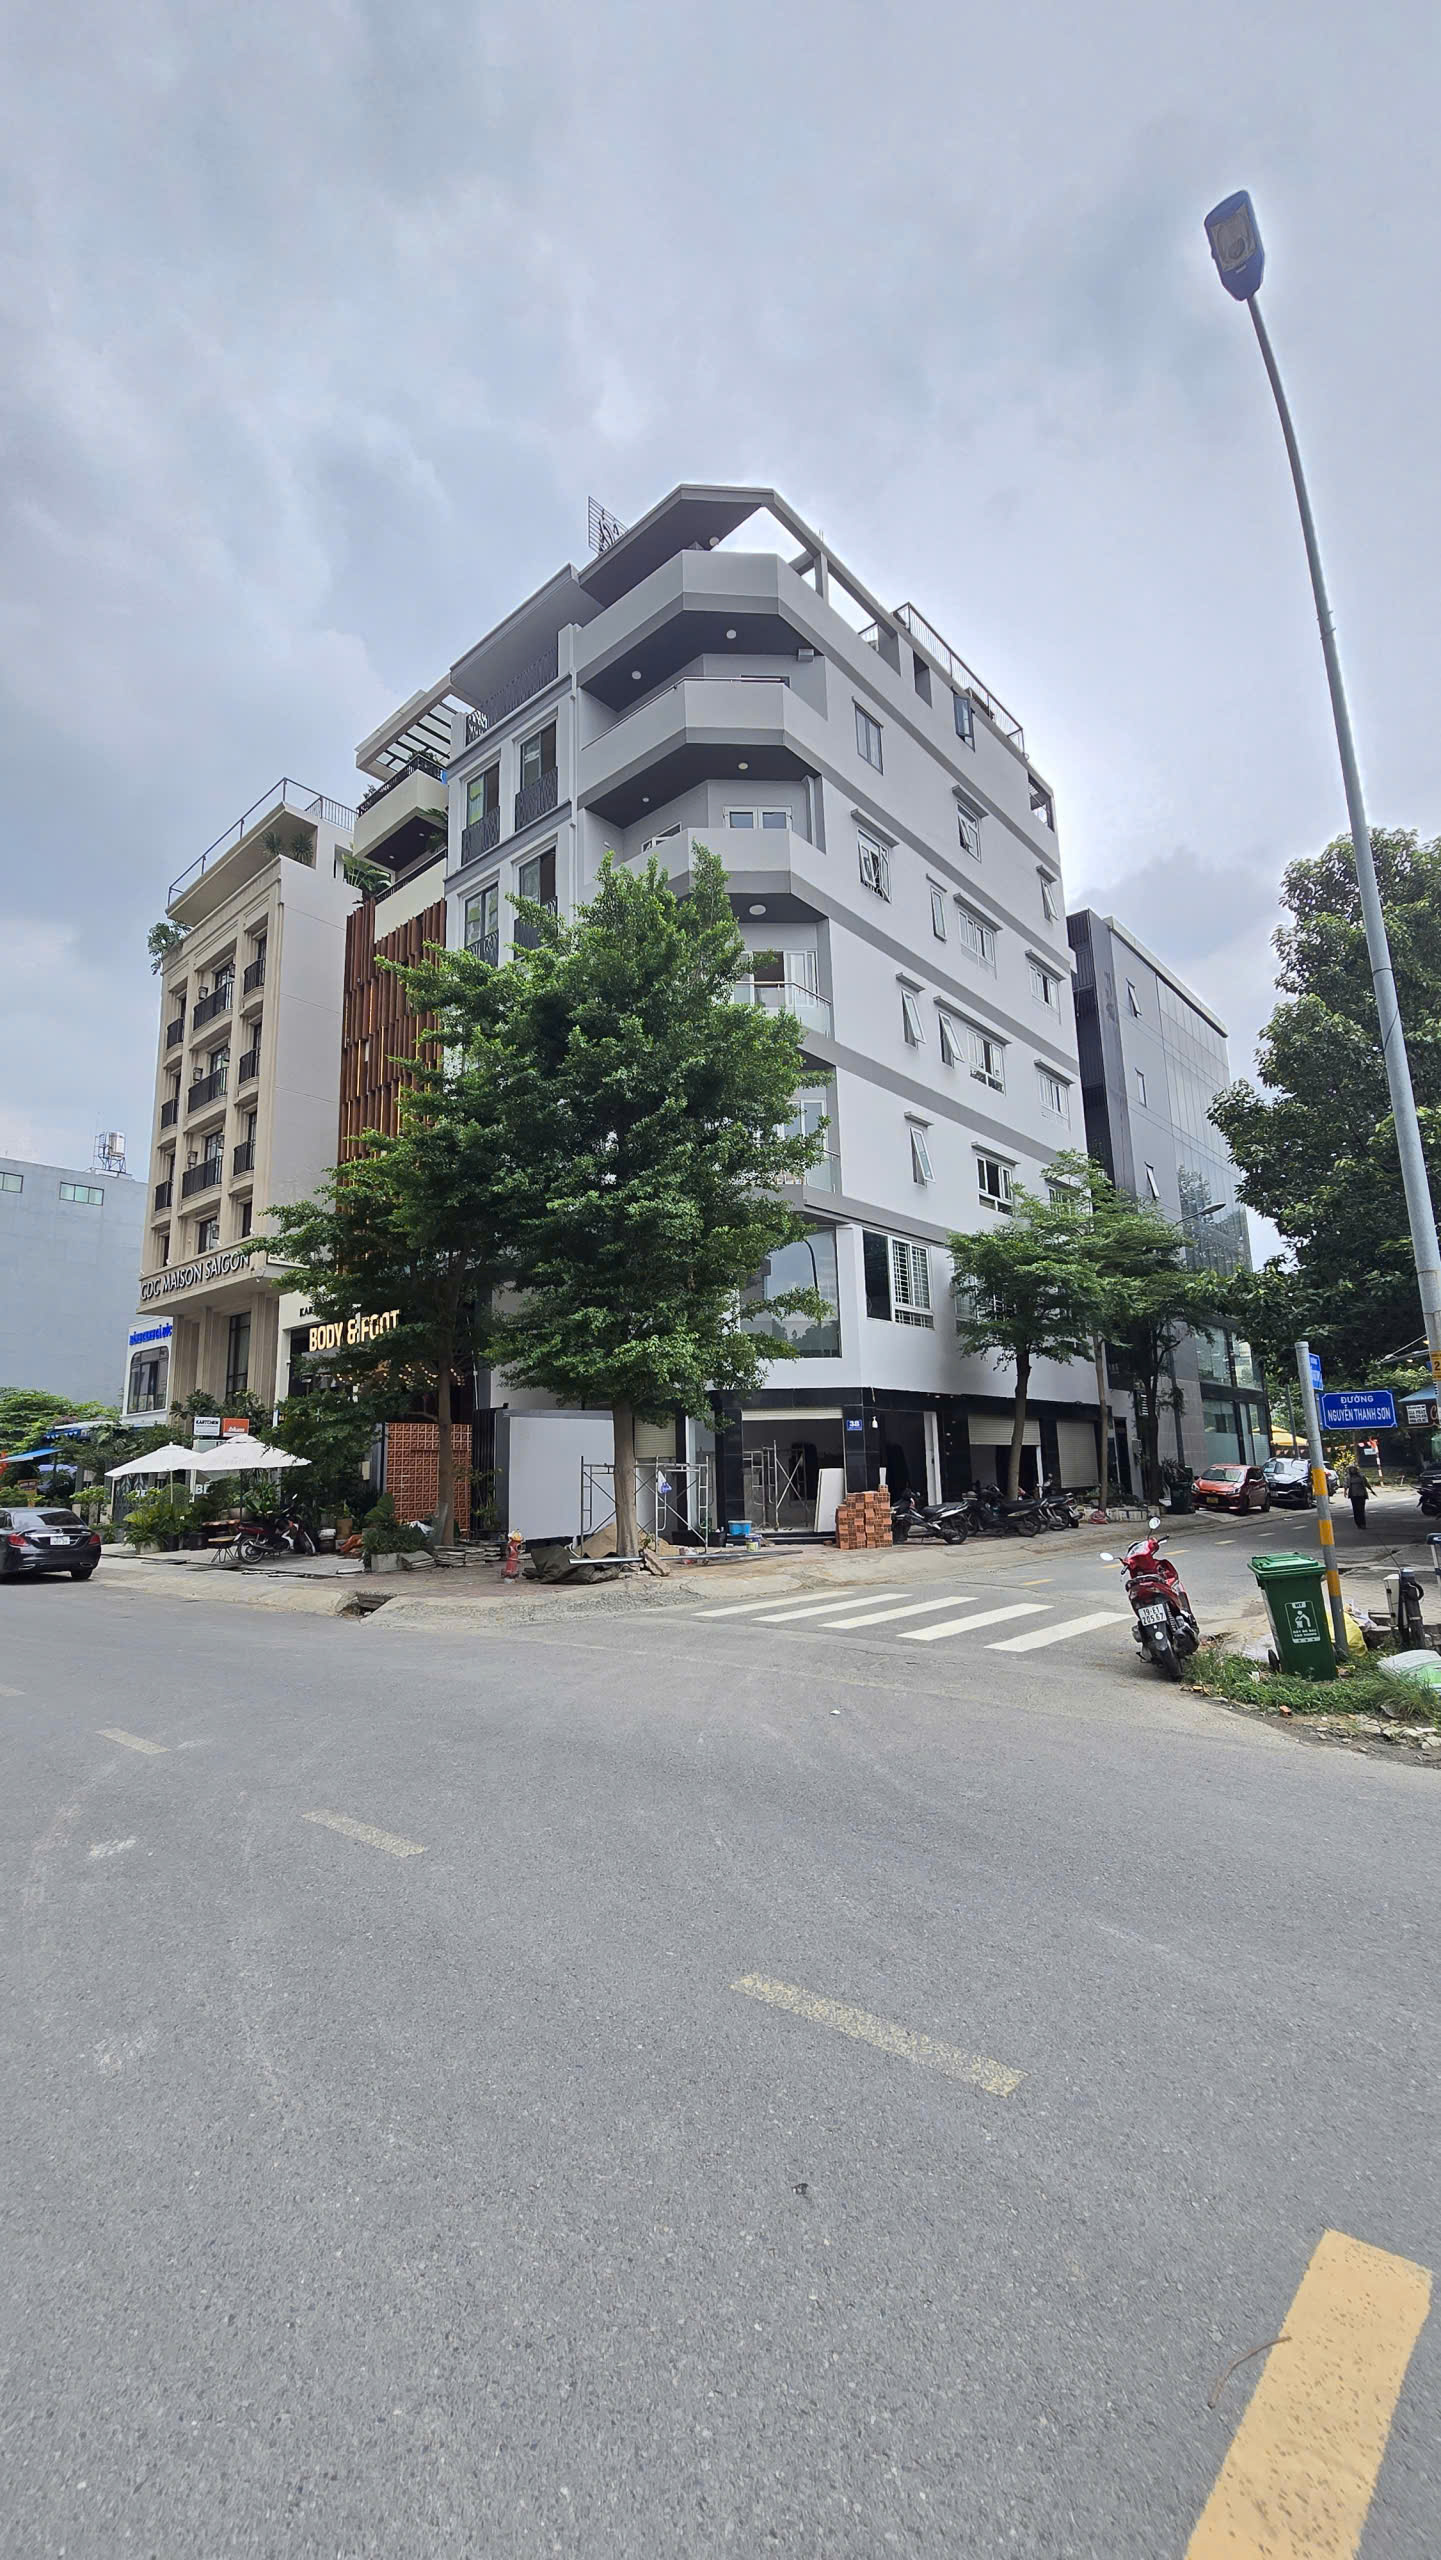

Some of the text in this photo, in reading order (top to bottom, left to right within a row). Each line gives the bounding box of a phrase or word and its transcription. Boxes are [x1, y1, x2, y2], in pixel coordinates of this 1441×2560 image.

[141, 1278, 162, 1301] CDC
[162, 1263, 204, 1293] MAISON
[205, 1251, 251, 1279] SAIGON
[309, 1322, 344, 1352] BODY
[347, 1319, 360, 1345] &
[1340, 1395, 1374, 1404] ĐƯỜNG
[1327, 1404, 1392, 1422] NGUYỄN THANH SƠN
